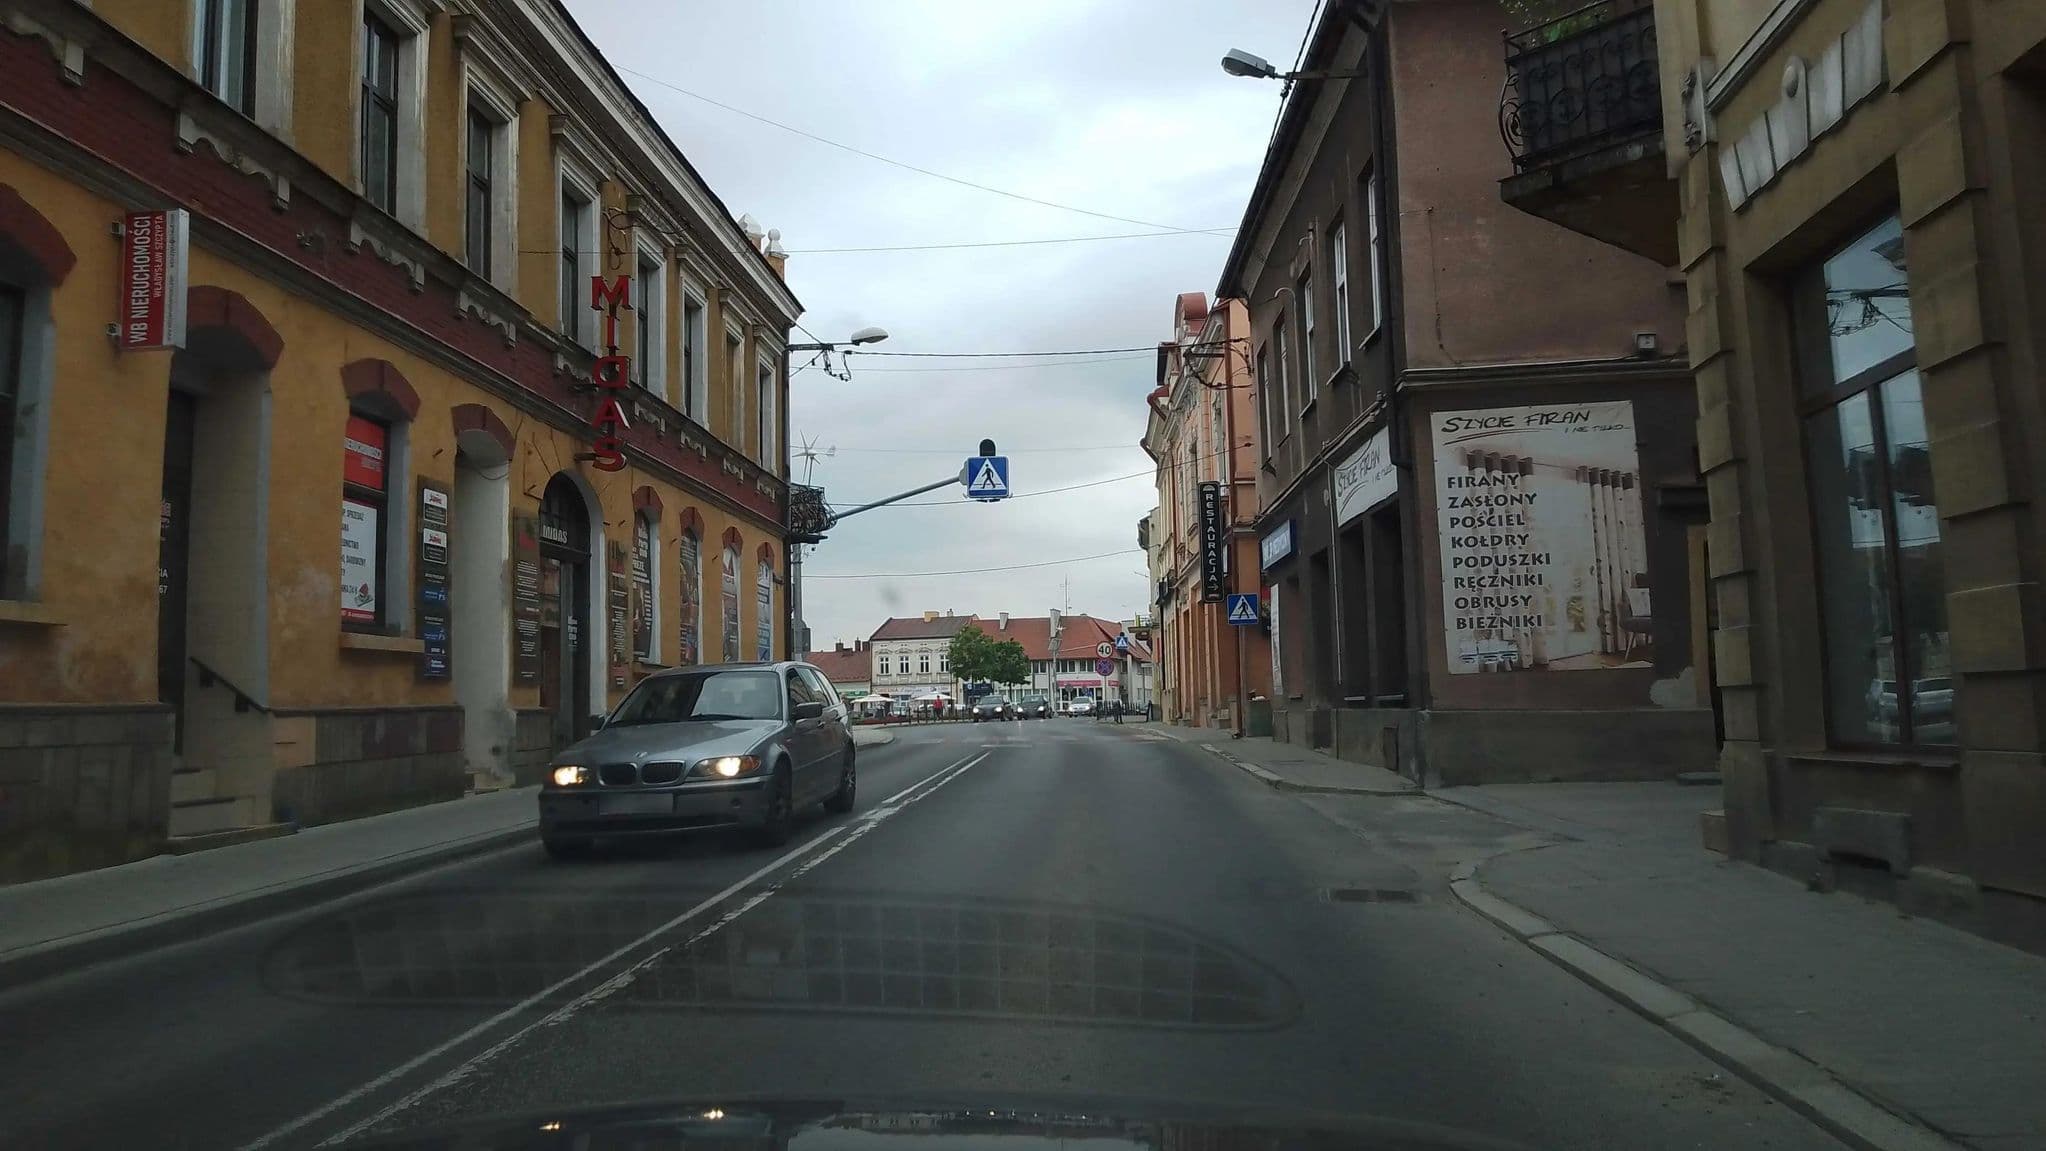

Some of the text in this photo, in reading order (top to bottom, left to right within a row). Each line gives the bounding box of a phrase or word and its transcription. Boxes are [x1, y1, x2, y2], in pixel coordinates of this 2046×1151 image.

[129, 216, 151, 343] WB NIERUCHOMOŚCI
[153, 252, 163, 298] WŁADYSŁAW
[591, 274, 633, 472] MIDAS
[1441, 410, 1590, 433] SZYCIE FIRAN
[1447, 474, 1519, 489] FIRANY
[1448, 493, 1537, 509] ZASŁONY
[1450, 510, 1525, 528] POŚCIEL
[542, 524, 568, 544] MIDAS
[1205, 493, 1218, 582] RESTAURACJA
[1451, 533, 1529, 549] KOŁDRY
[1453, 553, 1551, 568] PODUSZKI
[1454, 573, 1543, 592] RĘCZNIKI
[1454, 595, 1532, 609] OBRUSY
[1456, 613, 1542, 630] BIEŻNIKI
[1098, 645, 1110, 655] 40
